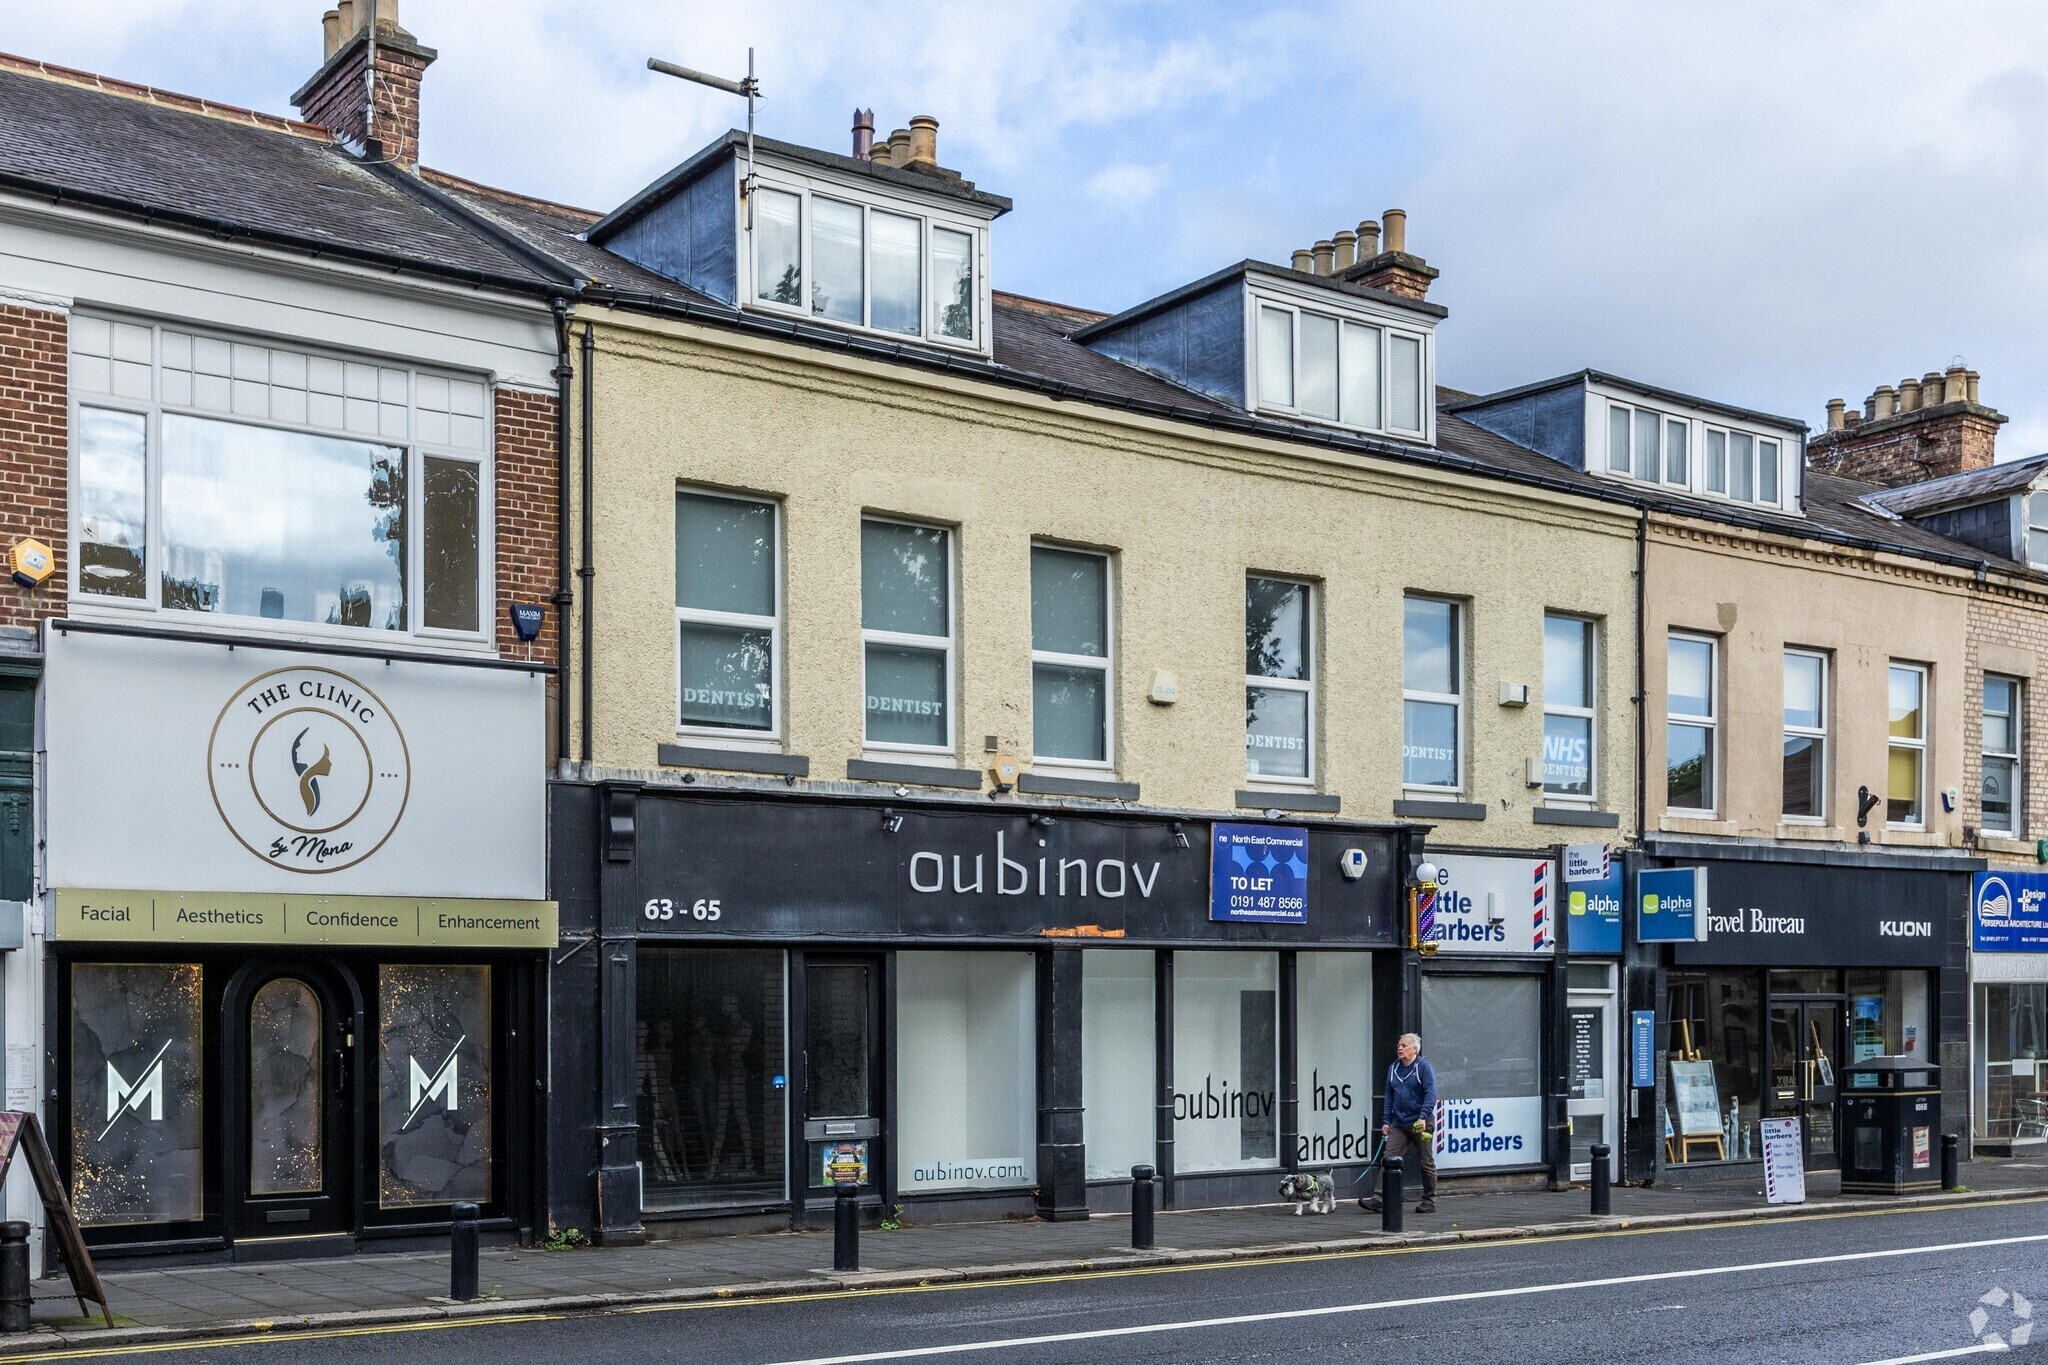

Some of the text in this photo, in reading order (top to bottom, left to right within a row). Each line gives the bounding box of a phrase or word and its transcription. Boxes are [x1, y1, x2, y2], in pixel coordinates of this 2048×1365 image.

[247, 681, 374, 724] THE CLINIC
[683, 688, 766, 708] DENTIST
[866, 696, 942, 716] DENTIST
[1246, 734, 1304, 750] DENTIST
[1543, 736, 1586, 762] NHS
[1402, 745, 1454, 760] DENTIST
[269, 836, 354, 863] by Mona
[1218, 834, 1304, 847] ne North East Commercial
[909, 829, 1160, 898] oubinov
[1568, 859, 1588, 867] little
[1569, 868, 1600, 876] barbers
[1230, 876, 1274, 891] TO LET
[1230, 895, 1303, 910] 0191 487 8566
[1436, 890, 1472, 914] ttle
[1660, 894, 1692, 912] alpha
[2022, 888, 2046, 901] Design
[80, 905, 130, 922] Facial
[644, 899, 674, 921] 63
[692, 899, 722, 922] 65
[1230, 908, 1302, 918] northeastcommercial.co.uk
[1588, 894, 1620, 916] alpha
[2022, 904, 2039, 912] Build
[176, 908, 264, 924] Aesthetics
[306, 910, 398, 928] Confidence
[438, 914, 540, 930] Enhancement
[1706, 908, 1804, 934] ravel Bureau
[1981, 918, 2009, 927] PERSEPOLIS
[2009, 919, 2042, 928] ARCHITECTURE
[1436, 918, 1506, 942] arbers
[1880, 920, 1931, 937] KUONI
[107, 1060, 163, 1122] M
[410, 1054, 458, 1112] M
[1312, 1066, 1352, 1112] has
[1174, 1072, 1274, 1121] oubinov
[1448, 1108, 1494, 1129] little
[1448, 1132, 1523, 1154] barbers
[914, 1161, 1022, 1181] oubinov.com
